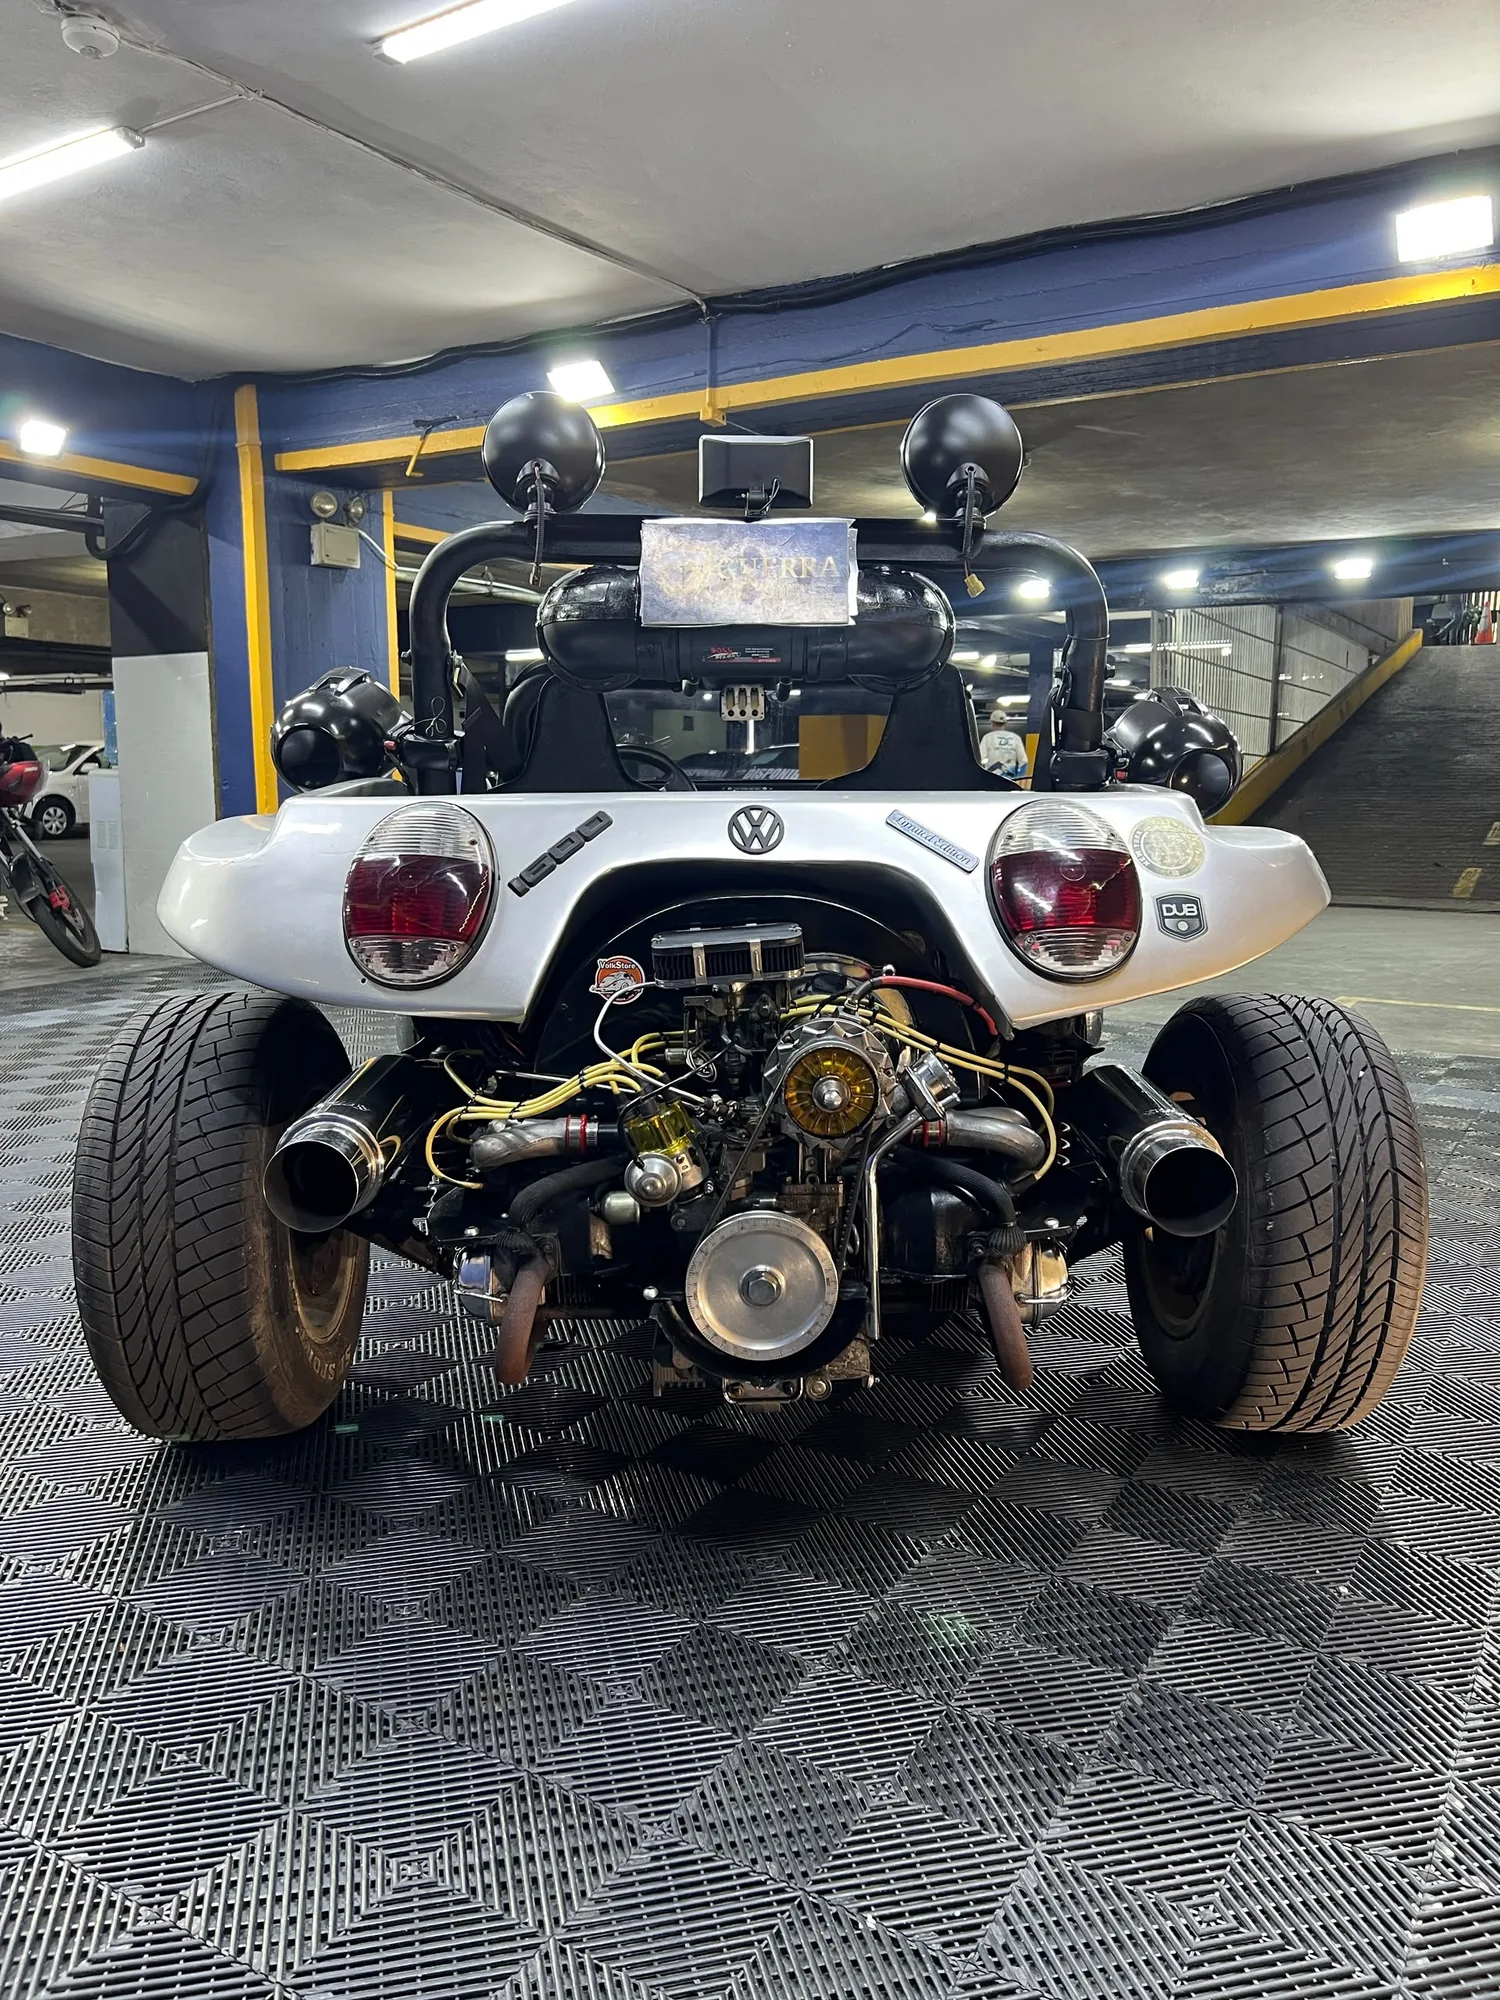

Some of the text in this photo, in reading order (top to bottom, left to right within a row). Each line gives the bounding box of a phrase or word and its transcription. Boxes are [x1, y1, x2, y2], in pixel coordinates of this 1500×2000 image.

[507, 811, 613, 897] 1600
[897, 816, 971, 865] Limited Edition
[1161, 904, 1198, 916] DUB
[600, 961, 636, 969] VolkStore
